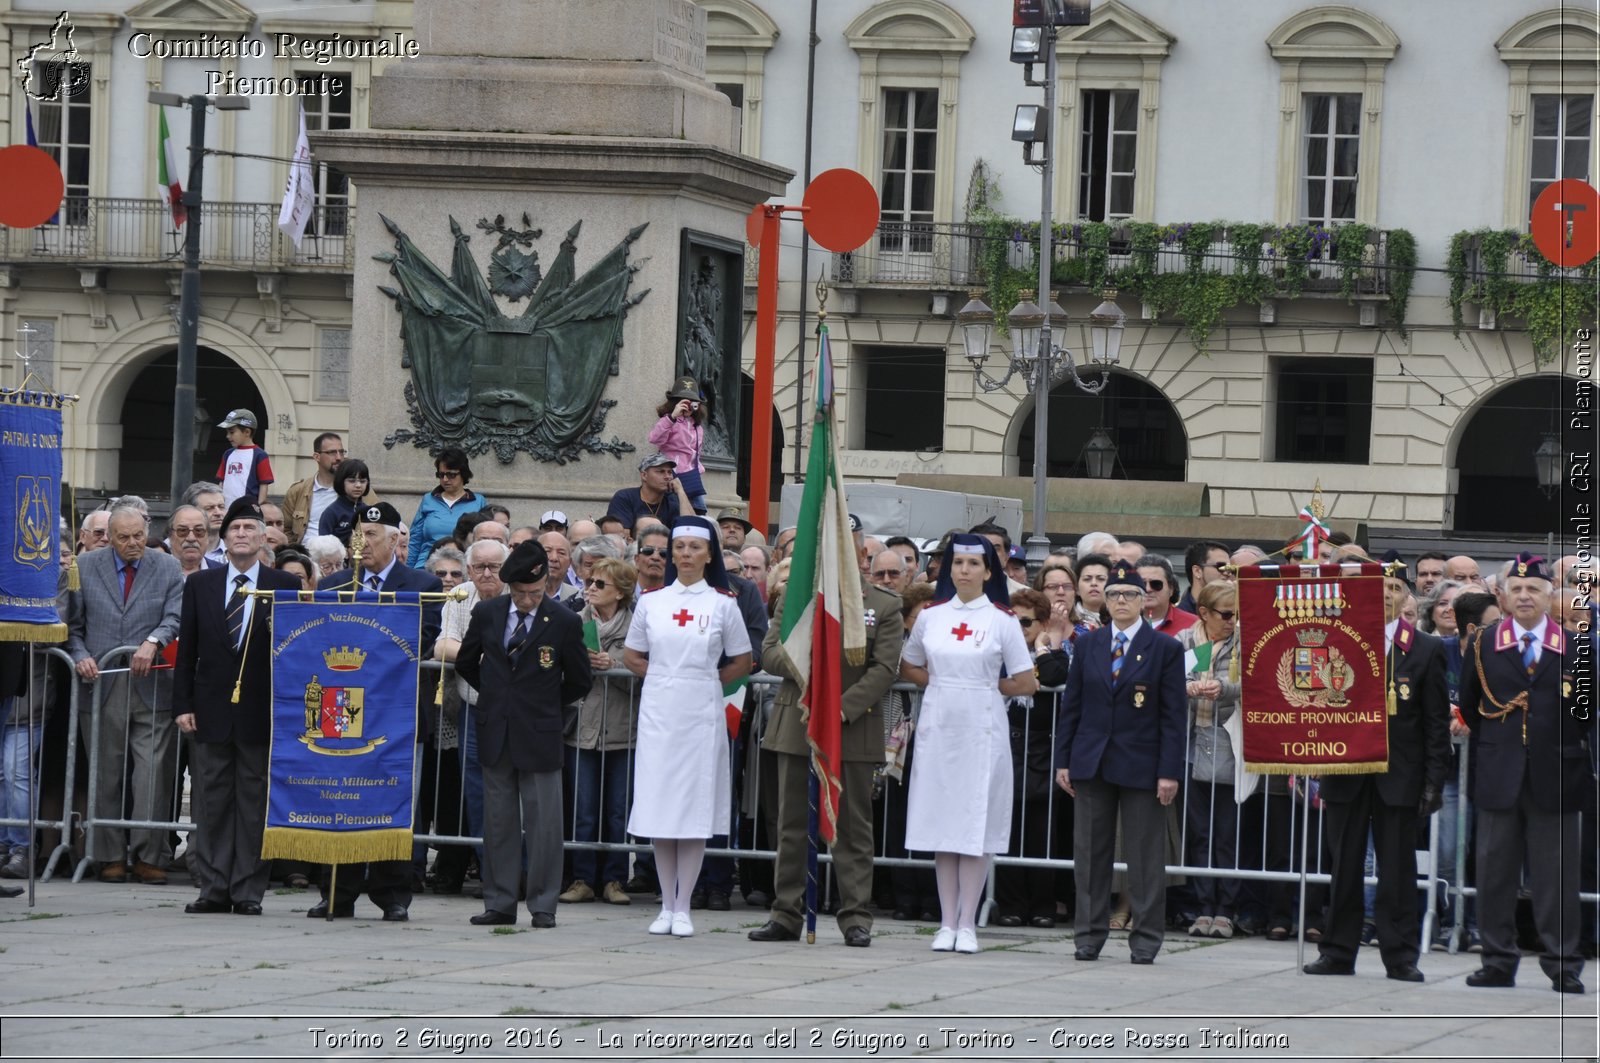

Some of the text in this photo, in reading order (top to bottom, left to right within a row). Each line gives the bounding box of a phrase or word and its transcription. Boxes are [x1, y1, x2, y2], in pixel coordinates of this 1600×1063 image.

[3, 431, 30, 448] PATRIA
[32, 434, 37, 448] E
[843, 455, 878, 468] TORO
[273, 613, 418, 662] Associazione Nazionale ex-allievi
[1246, 616, 1380, 677] Associazione Nazionale Polizia di Stato
[1247, 711, 1382, 724] SEZIONE PROVINCIALE
[1307, 728, 1318, 738] di
[1281, 742, 1347, 756] TORINO
[286, 776, 398, 786] Accademia Militare di
[320, 789, 360, 800] Modena
[288, 811, 392, 824] Sezione Piemonte
